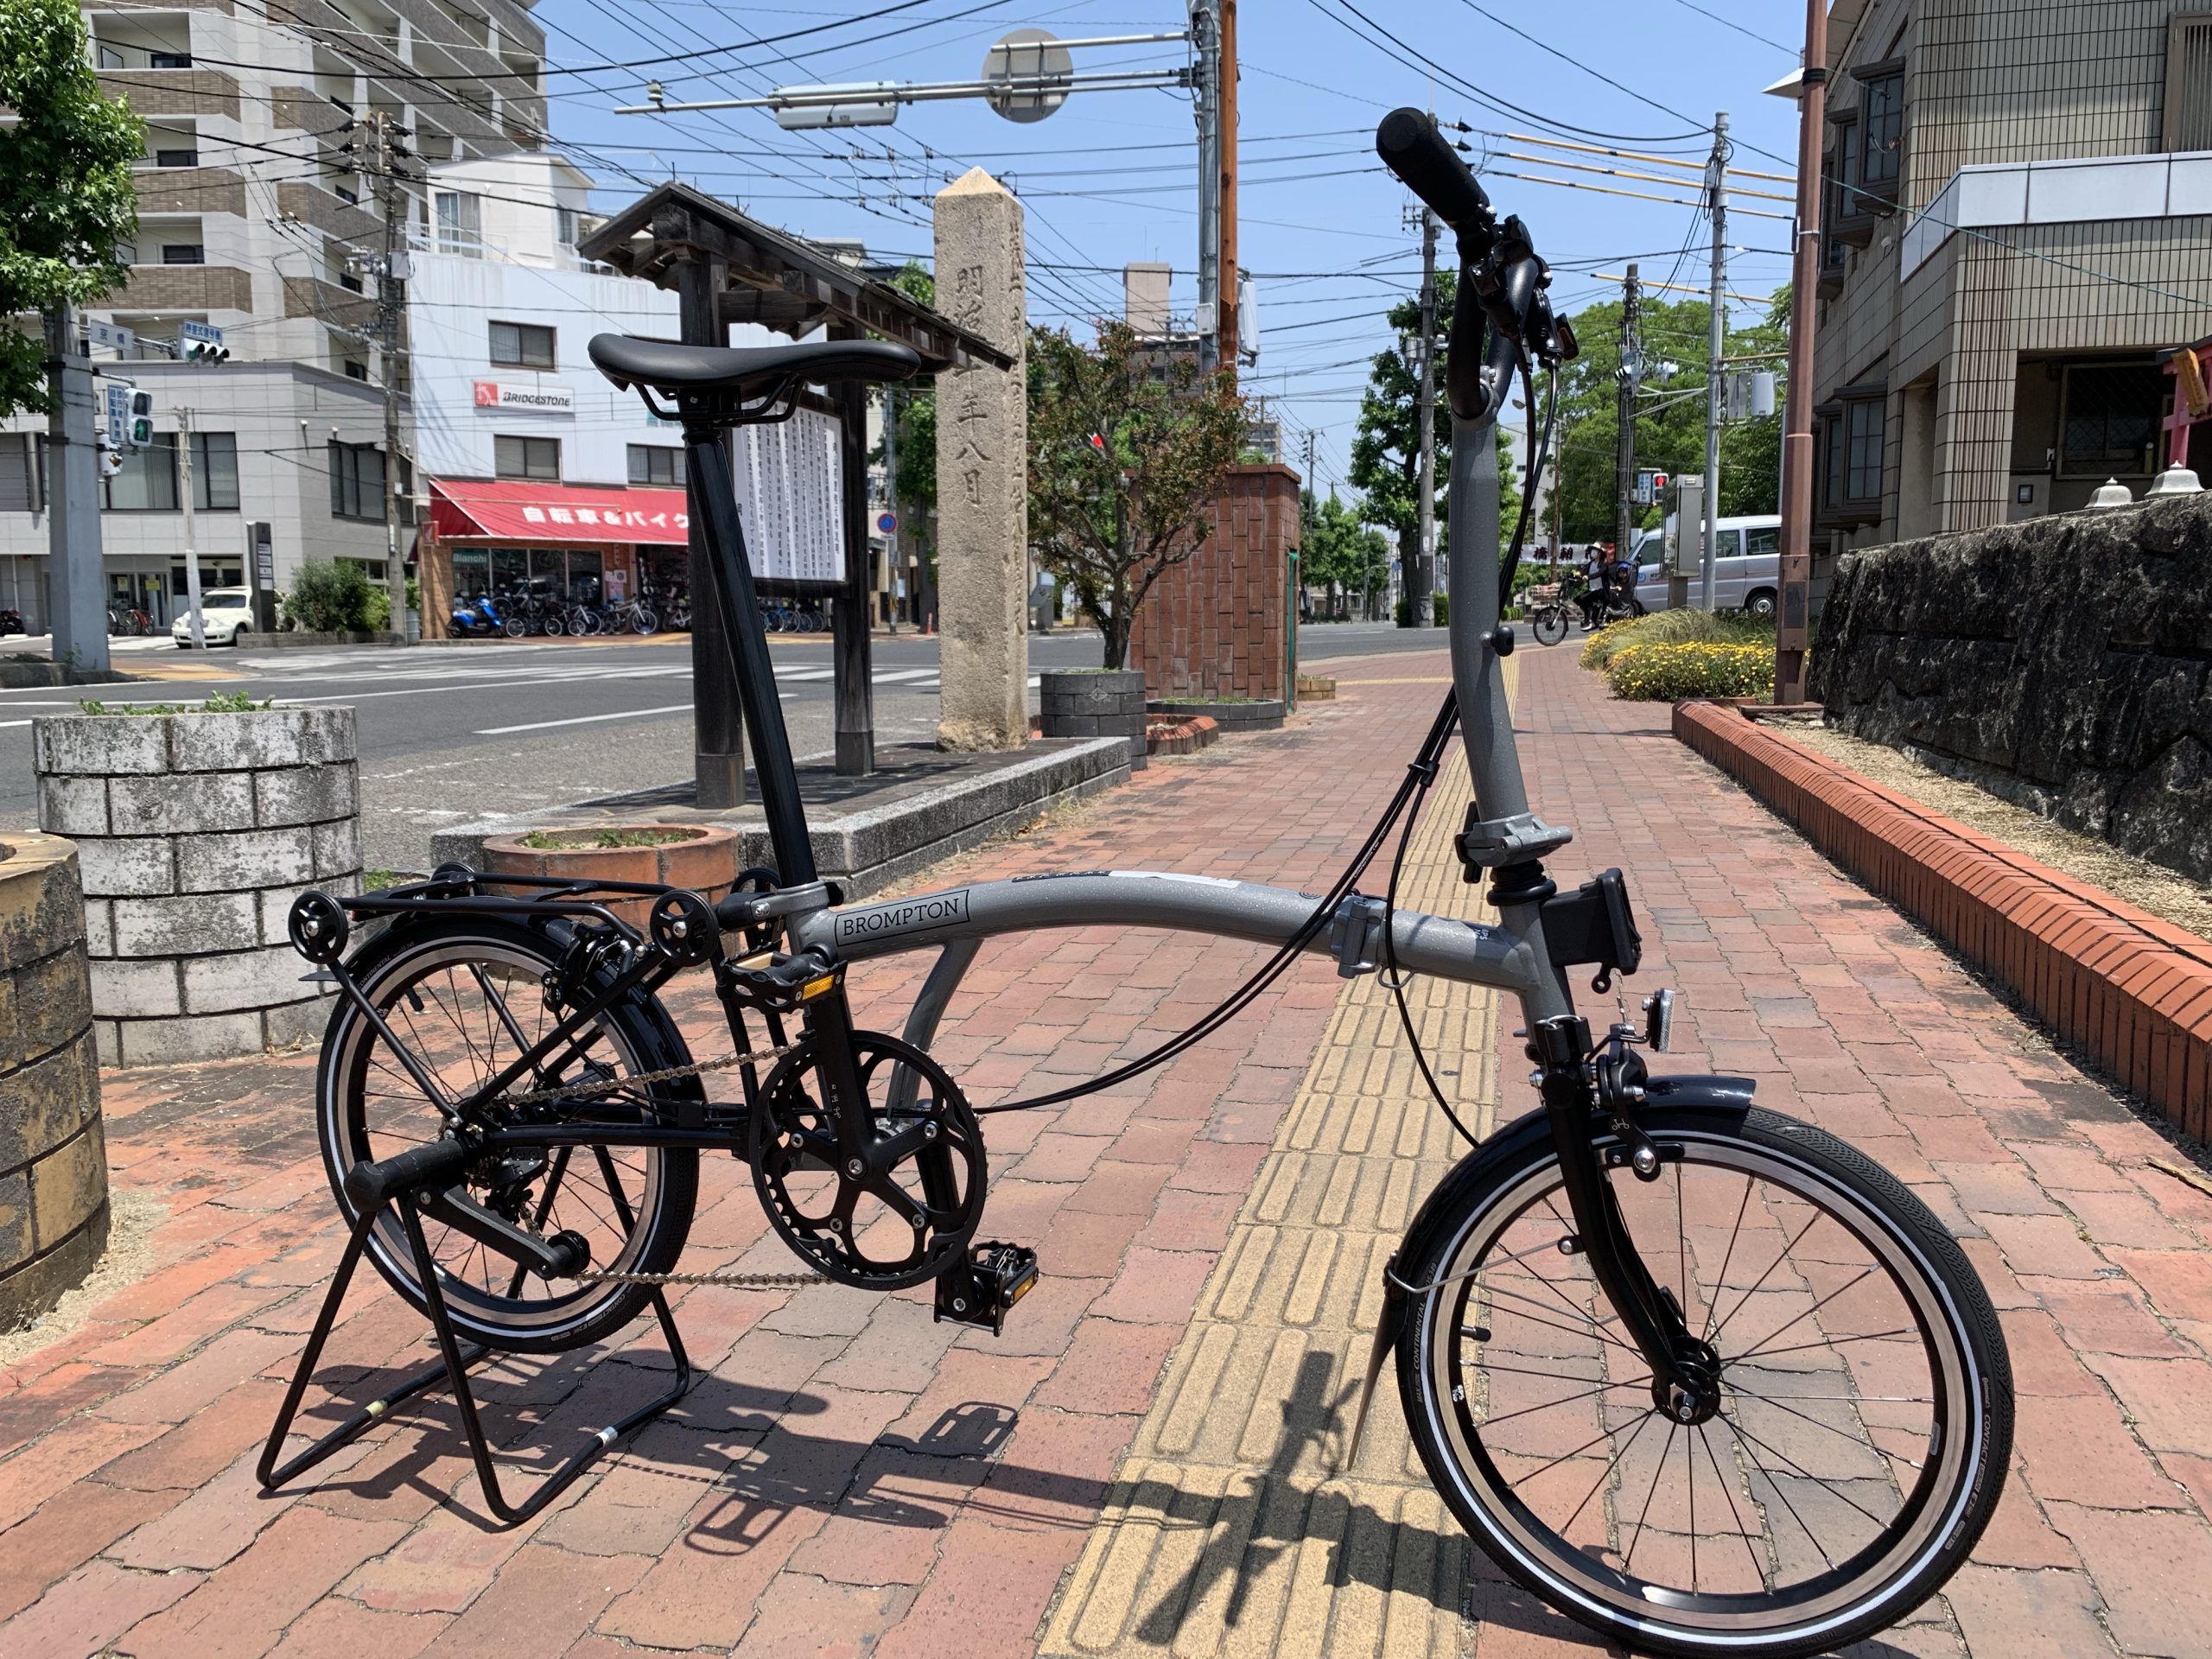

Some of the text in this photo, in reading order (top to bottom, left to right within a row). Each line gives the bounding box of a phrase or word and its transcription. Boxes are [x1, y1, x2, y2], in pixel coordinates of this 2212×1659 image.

[99, 327, 125, 345] 京橋
[502, 391, 570, 406] BRIDGESTONE
[522, 506, 689, 528] 自転車&バイク
[452, 553, 487, 563] Bianchi
[842, 898, 959, 936] BROMPTON
[357, 955, 391, 988] CONTINENTAL
[601, 1294, 626, 1318] CONTACT
[1413, 1301, 1426, 1370] CONTINENTAL
[1980, 1414, 1992, 1465] CONTACT
